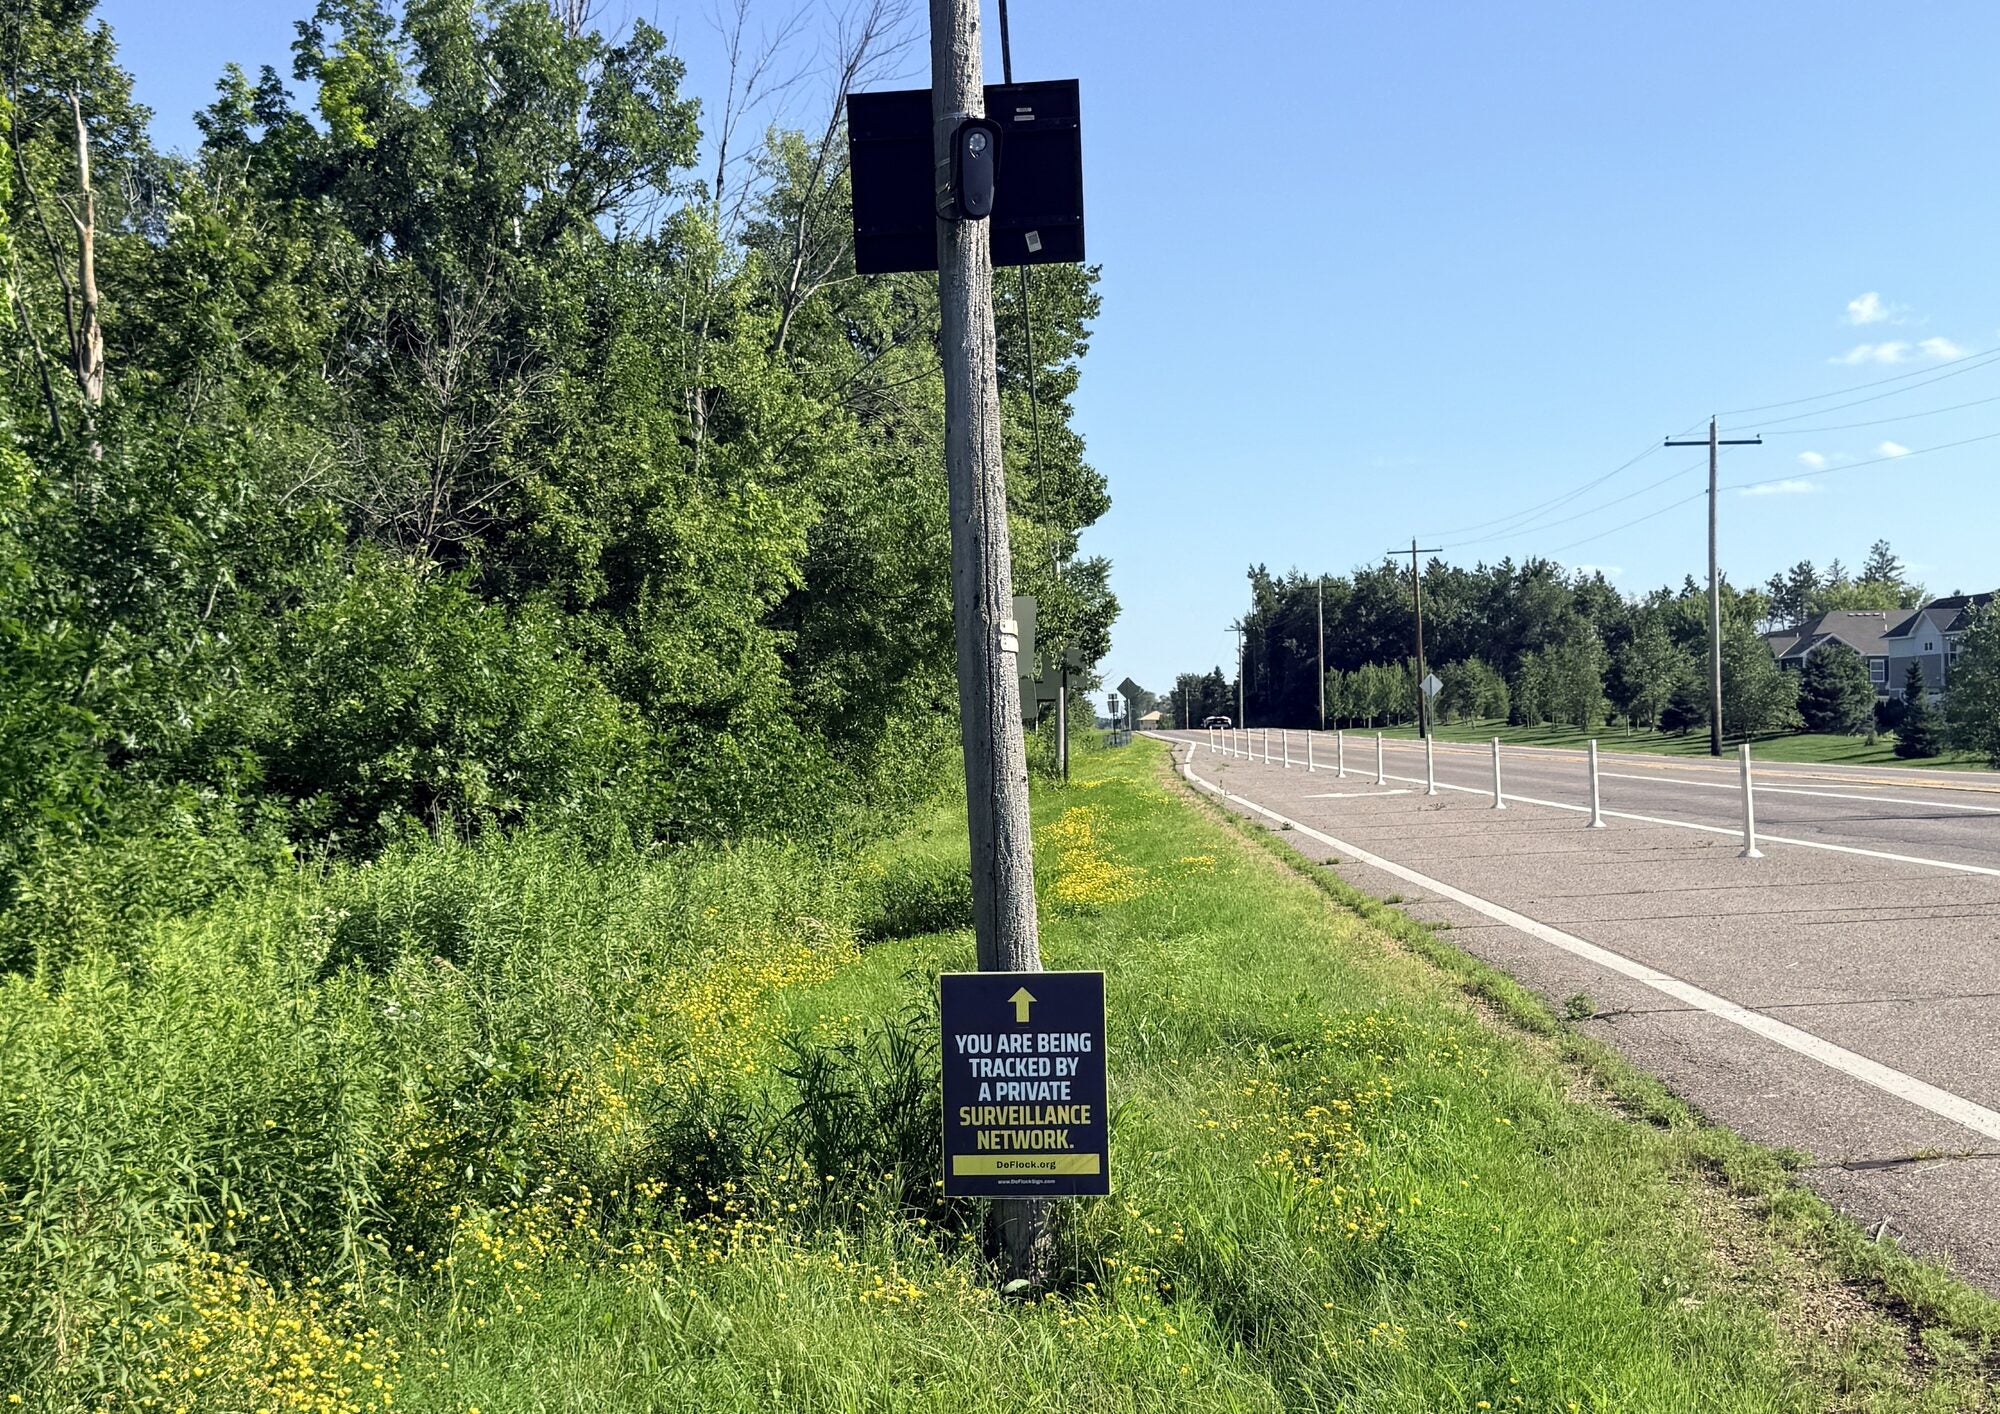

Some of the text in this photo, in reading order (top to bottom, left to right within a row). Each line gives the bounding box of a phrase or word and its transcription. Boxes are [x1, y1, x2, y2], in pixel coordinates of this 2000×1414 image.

[955, 1033, 1092, 1054] YOU ARE BEING
[968, 1057, 1080, 1078] TRACKED BY
[978, 1081, 1071, 1101] A PRIVATE
[959, 1105, 1091, 1126] SURVEILLANCE
[977, 1129, 1074, 1150] NETWORK.
[996, 1161, 1056, 1170] DeFlock.org
